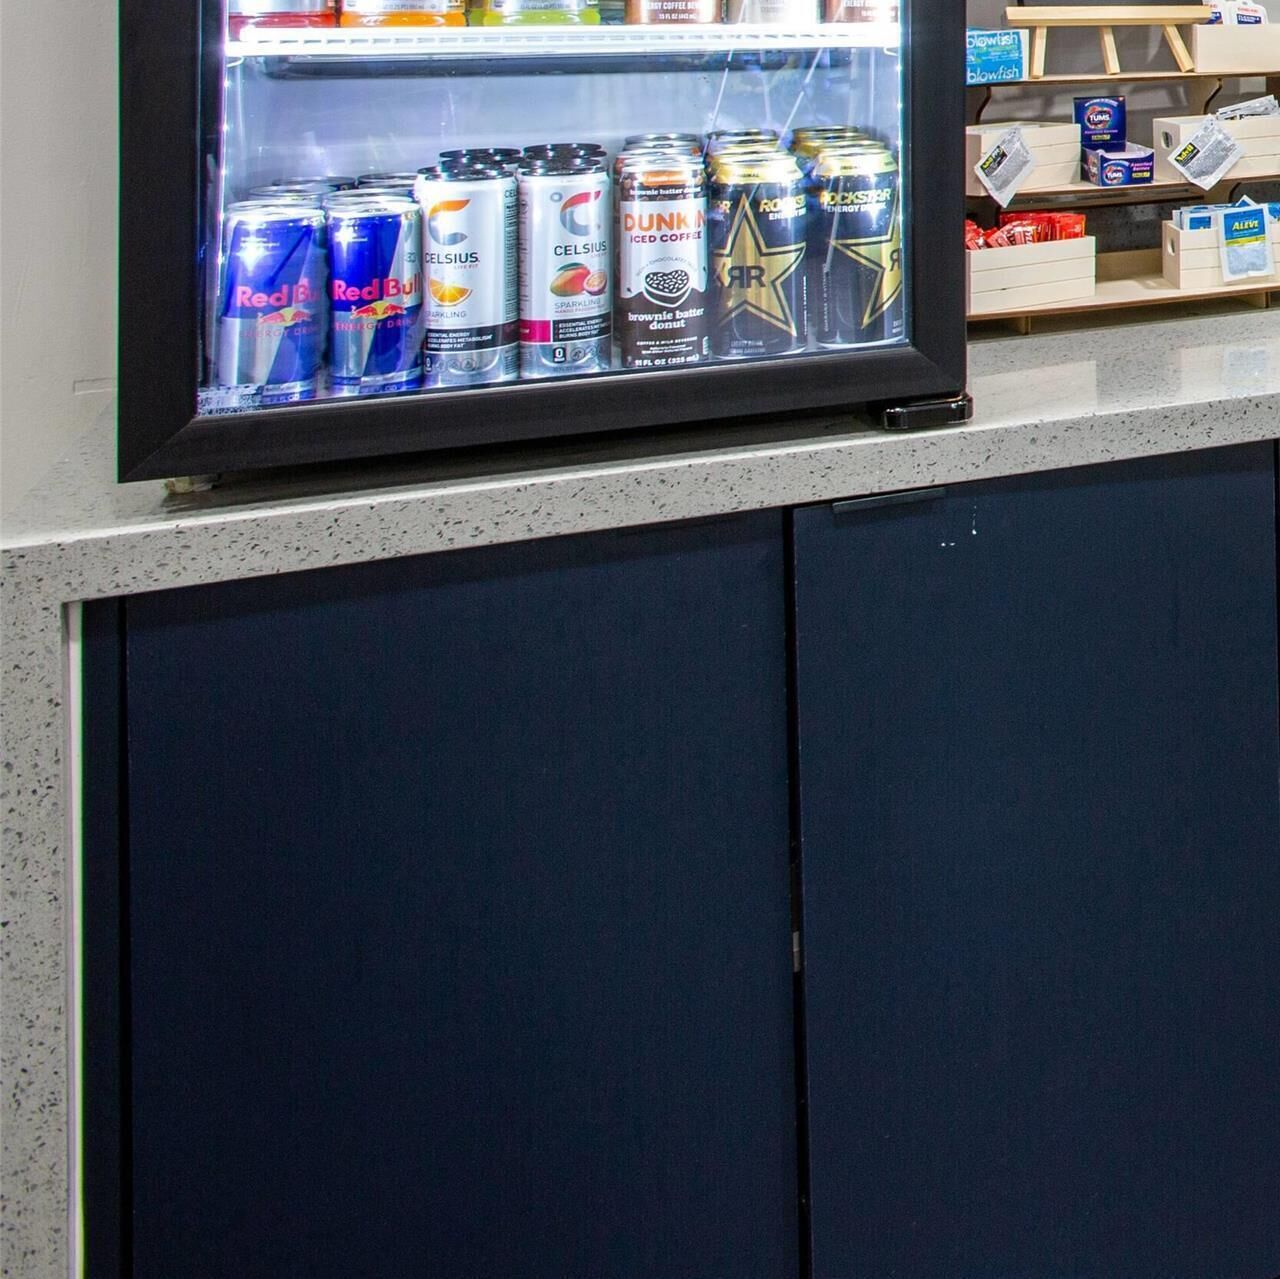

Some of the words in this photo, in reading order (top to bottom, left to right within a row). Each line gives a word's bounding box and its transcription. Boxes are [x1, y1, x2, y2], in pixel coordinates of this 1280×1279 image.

[663, 1, 686, 10] COFFEE
[966, 65, 1020, 83] blowfish
[1089, 113, 1110, 122] TUMS
[1175, 143, 1195, 163] Advil
[1107, 171, 1123, 179] TUMS
[1232, 220, 1260, 231] ALEVE
[630, 235, 657, 244] ICED
[659, 231, 702, 243] COFFEE
[554, 241, 607, 257] CELSIUS
[425, 251, 479, 264] CELSIUS
[332, 279, 379, 301] Red
[383, 272, 422, 297] Bull
[236, 284, 288, 308] Red
[554, 298, 602, 309] SPARKLING
[627, 310, 674, 322] brownie
[675, 307, 705, 320] batter
[648, 318, 687, 330] donut
